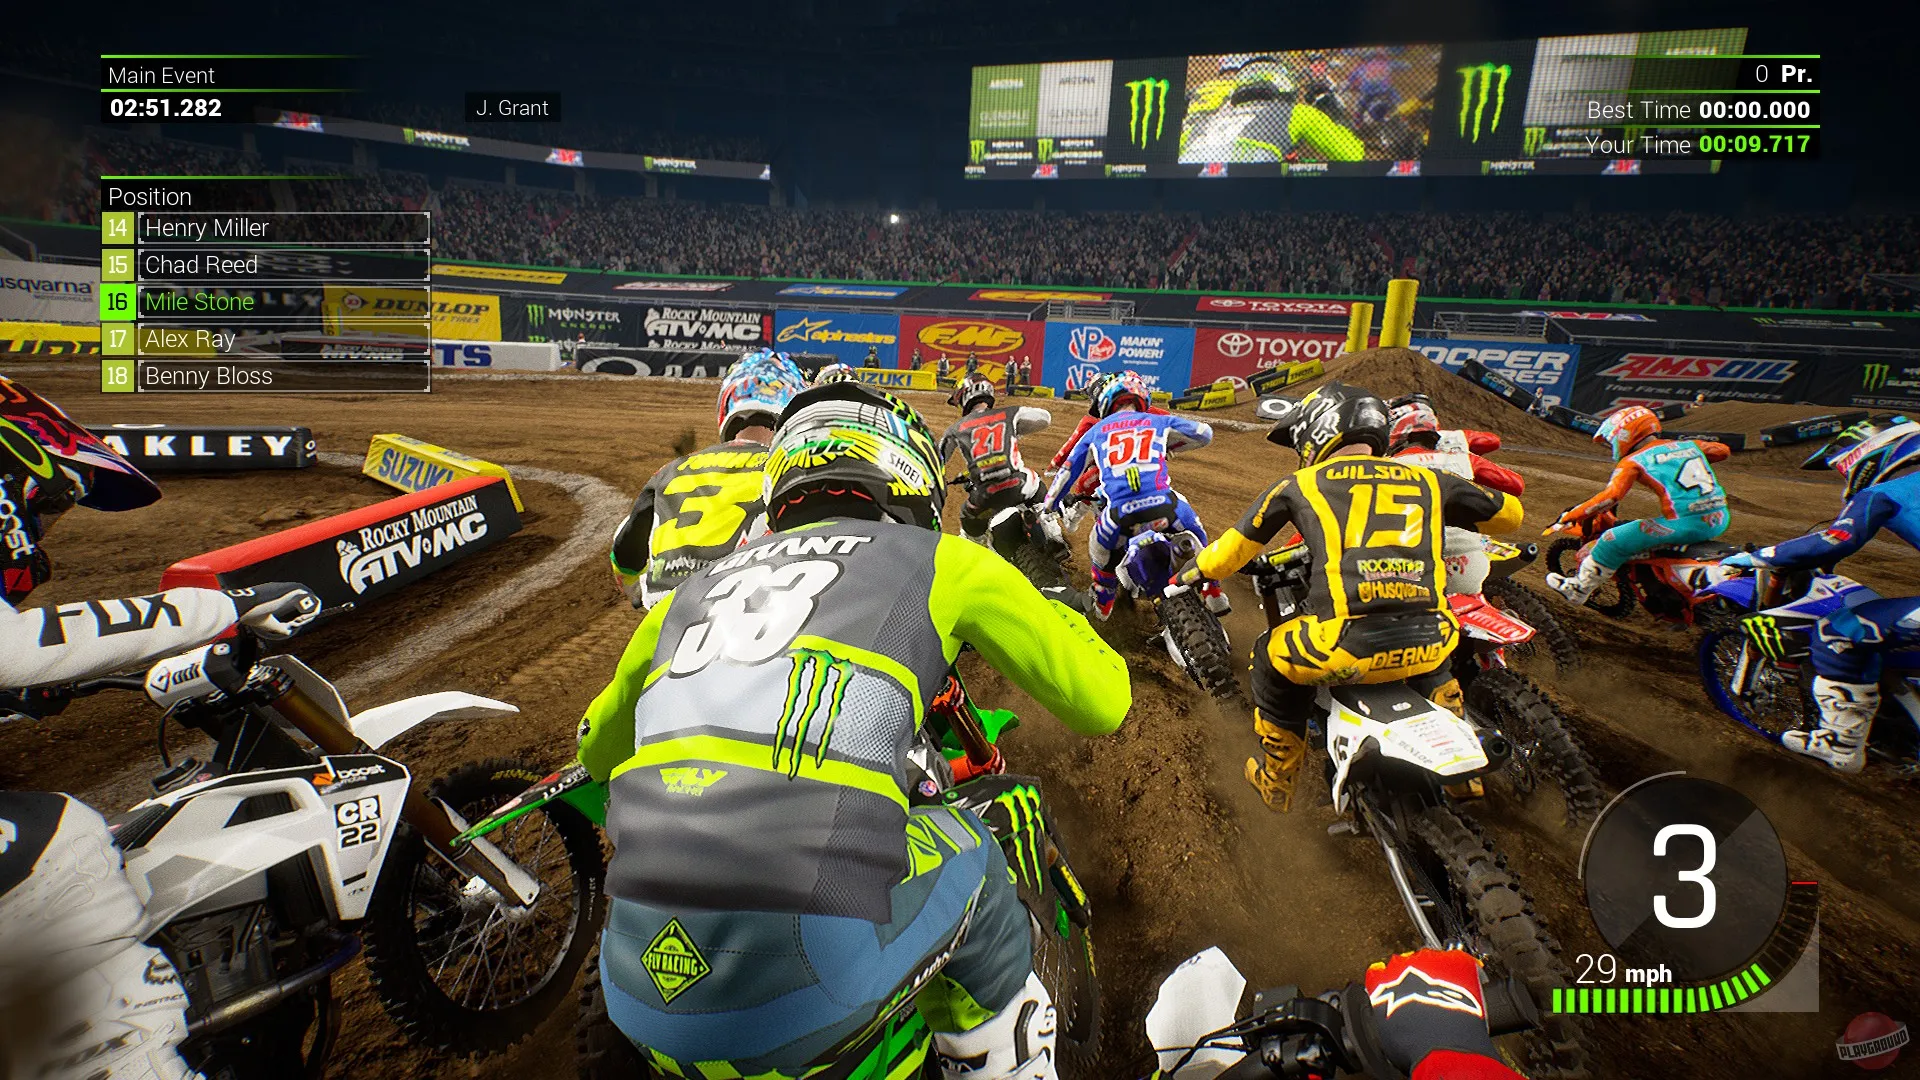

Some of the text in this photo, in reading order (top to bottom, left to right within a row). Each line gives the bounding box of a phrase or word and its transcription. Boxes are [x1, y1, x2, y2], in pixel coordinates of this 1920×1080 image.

[373, 298, 490, 316] DUNLOP
[547, 306, 621, 324] MONSTER
[661, 307, 761, 325] ROCKY MOUNTAIN
[926, 326, 1024, 347] FMF
[1071, 326, 1104, 361] VP
[1120, 335, 1164, 348] MAKIN'
[1255, 338, 1350, 359] TOYOTA
[1118, 347, 1164, 359] POWER!
[1290, 366, 1314, 380] THOR
[1598, 353, 1797, 383] AMSOIL
[1204, 395, 1227, 406] THOR
[1605, 383, 1634, 392] The
[1635, 385, 1673, 396] First
[103, 435, 293, 457] AKLEY
[970, 421, 1007, 461] 21
[1107, 427, 1156, 467] 51
[378, 447, 455, 492] SUZUKI
[887, 451, 921, 485] SHOEI
[1325, 464, 1422, 483] WILSON
[1676, 456, 1715, 496] 4
[358, 494, 479, 554] ROCKY MOUNTAIN
[652, 470, 765, 558] 3
[1343, 483, 1424, 549] 15
[707, 535, 873, 578] GRANT
[38, 593, 184, 648] FOX
[668, 558, 845, 678] 33
[336, 764, 387, 779] boost
[337, 797, 379, 826] CR
[340, 821, 379, 849] 22
[648, 952, 698, 977] FLY RACING
